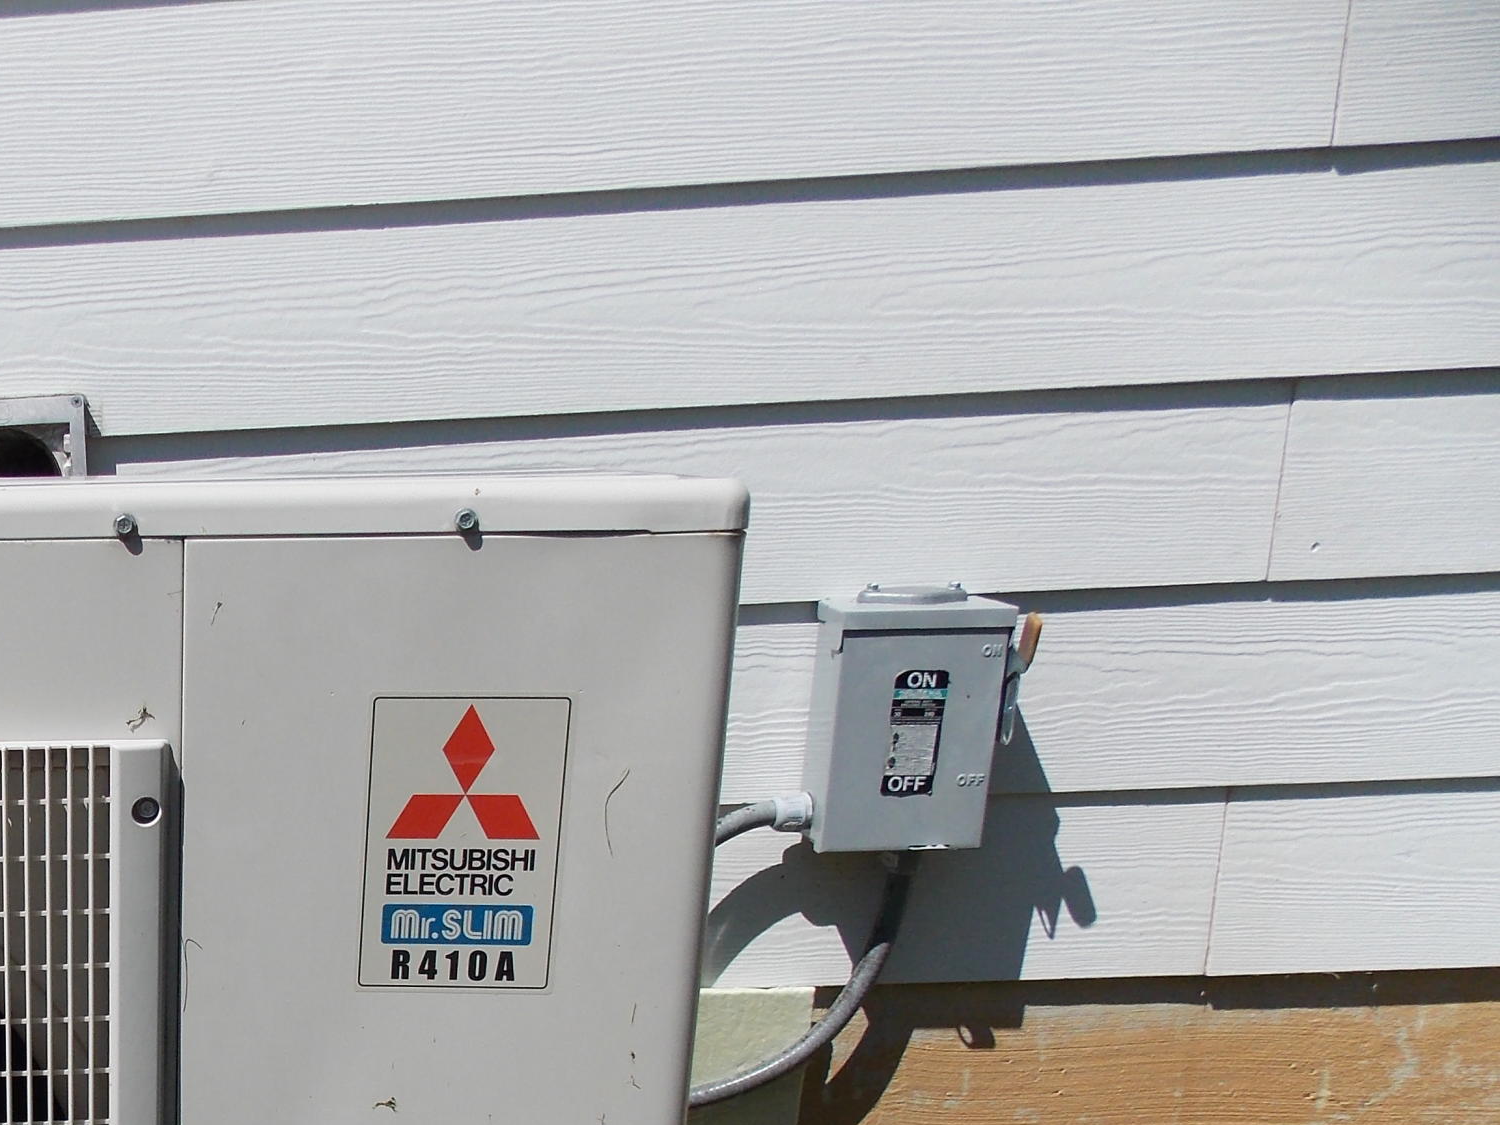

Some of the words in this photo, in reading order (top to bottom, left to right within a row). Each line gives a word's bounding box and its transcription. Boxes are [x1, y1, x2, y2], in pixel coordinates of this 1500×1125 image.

[907, 671, 937, 688] ON
[887, 776, 927, 791] OFF
[955, 773, 985, 787] OFF
[387, 848, 535, 871] MITSUBISHI
[385, 873, 514, 896] ELECTRIC
[390, 949, 515, 981] R410A
